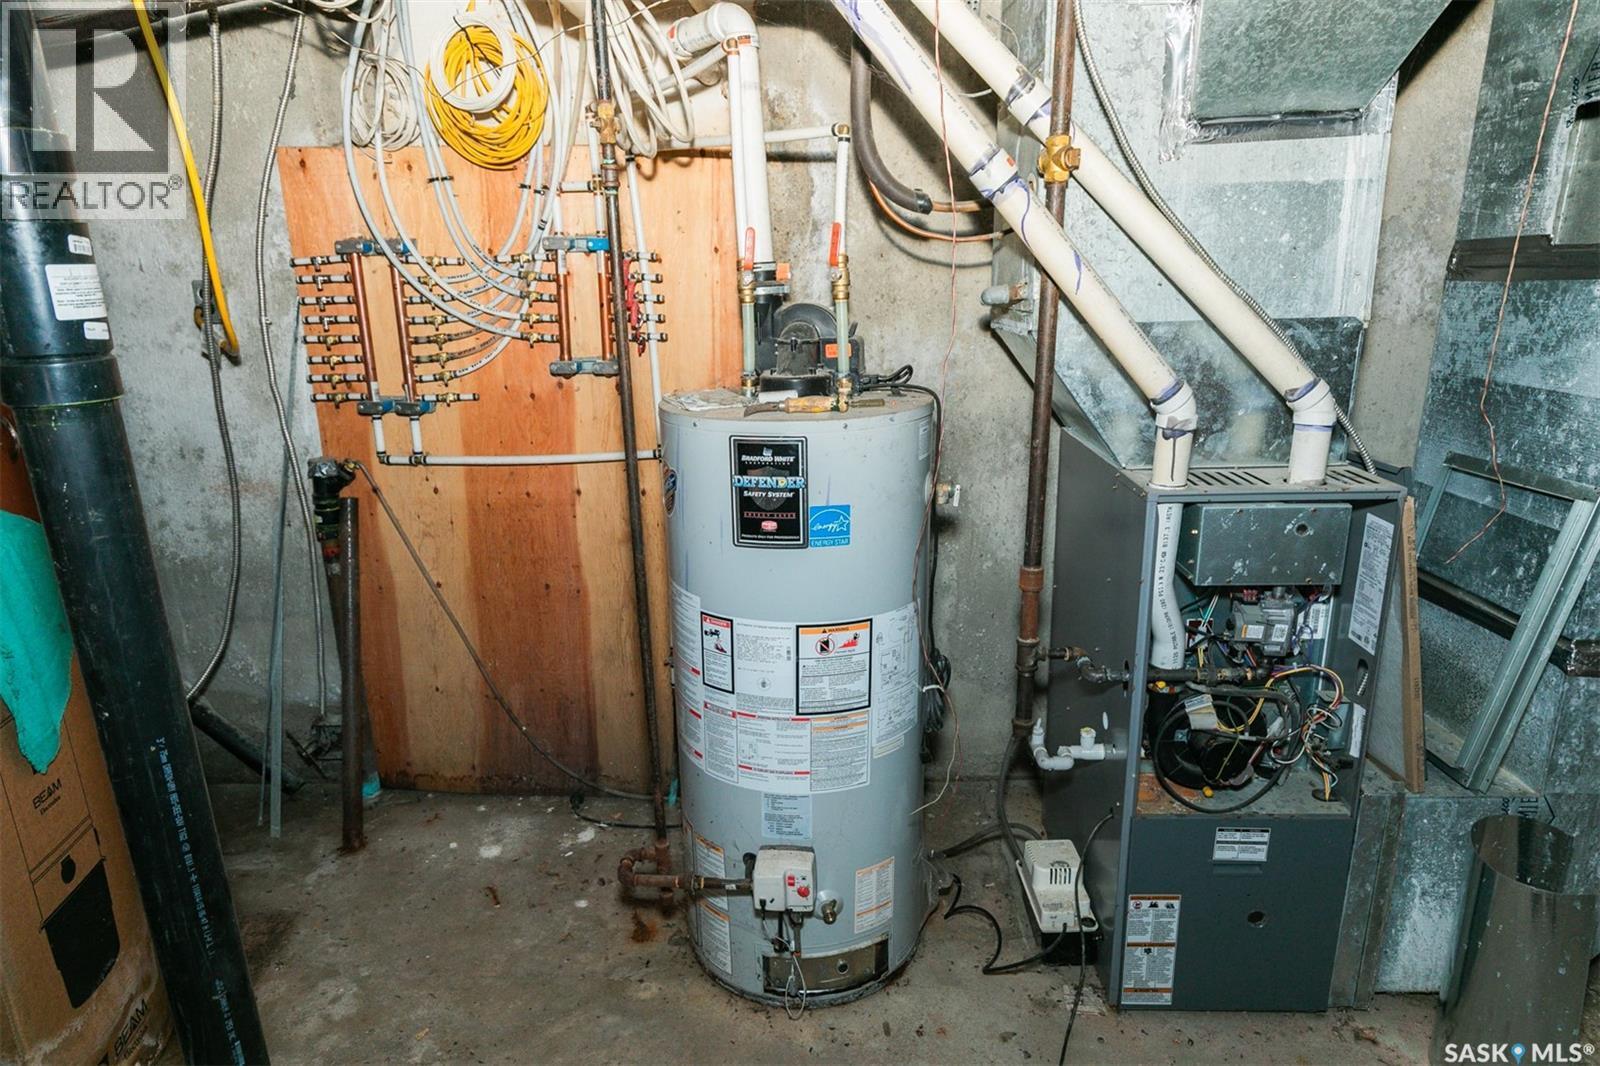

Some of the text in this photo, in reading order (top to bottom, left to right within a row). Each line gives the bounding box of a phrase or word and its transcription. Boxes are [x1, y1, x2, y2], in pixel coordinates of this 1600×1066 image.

[733, 475, 806, 489] DEFENDER
[811, 539, 834, 547] ENERGY
[32, 778, 62, 808] BEAM
[113, 999, 150, 1059] BEAM
